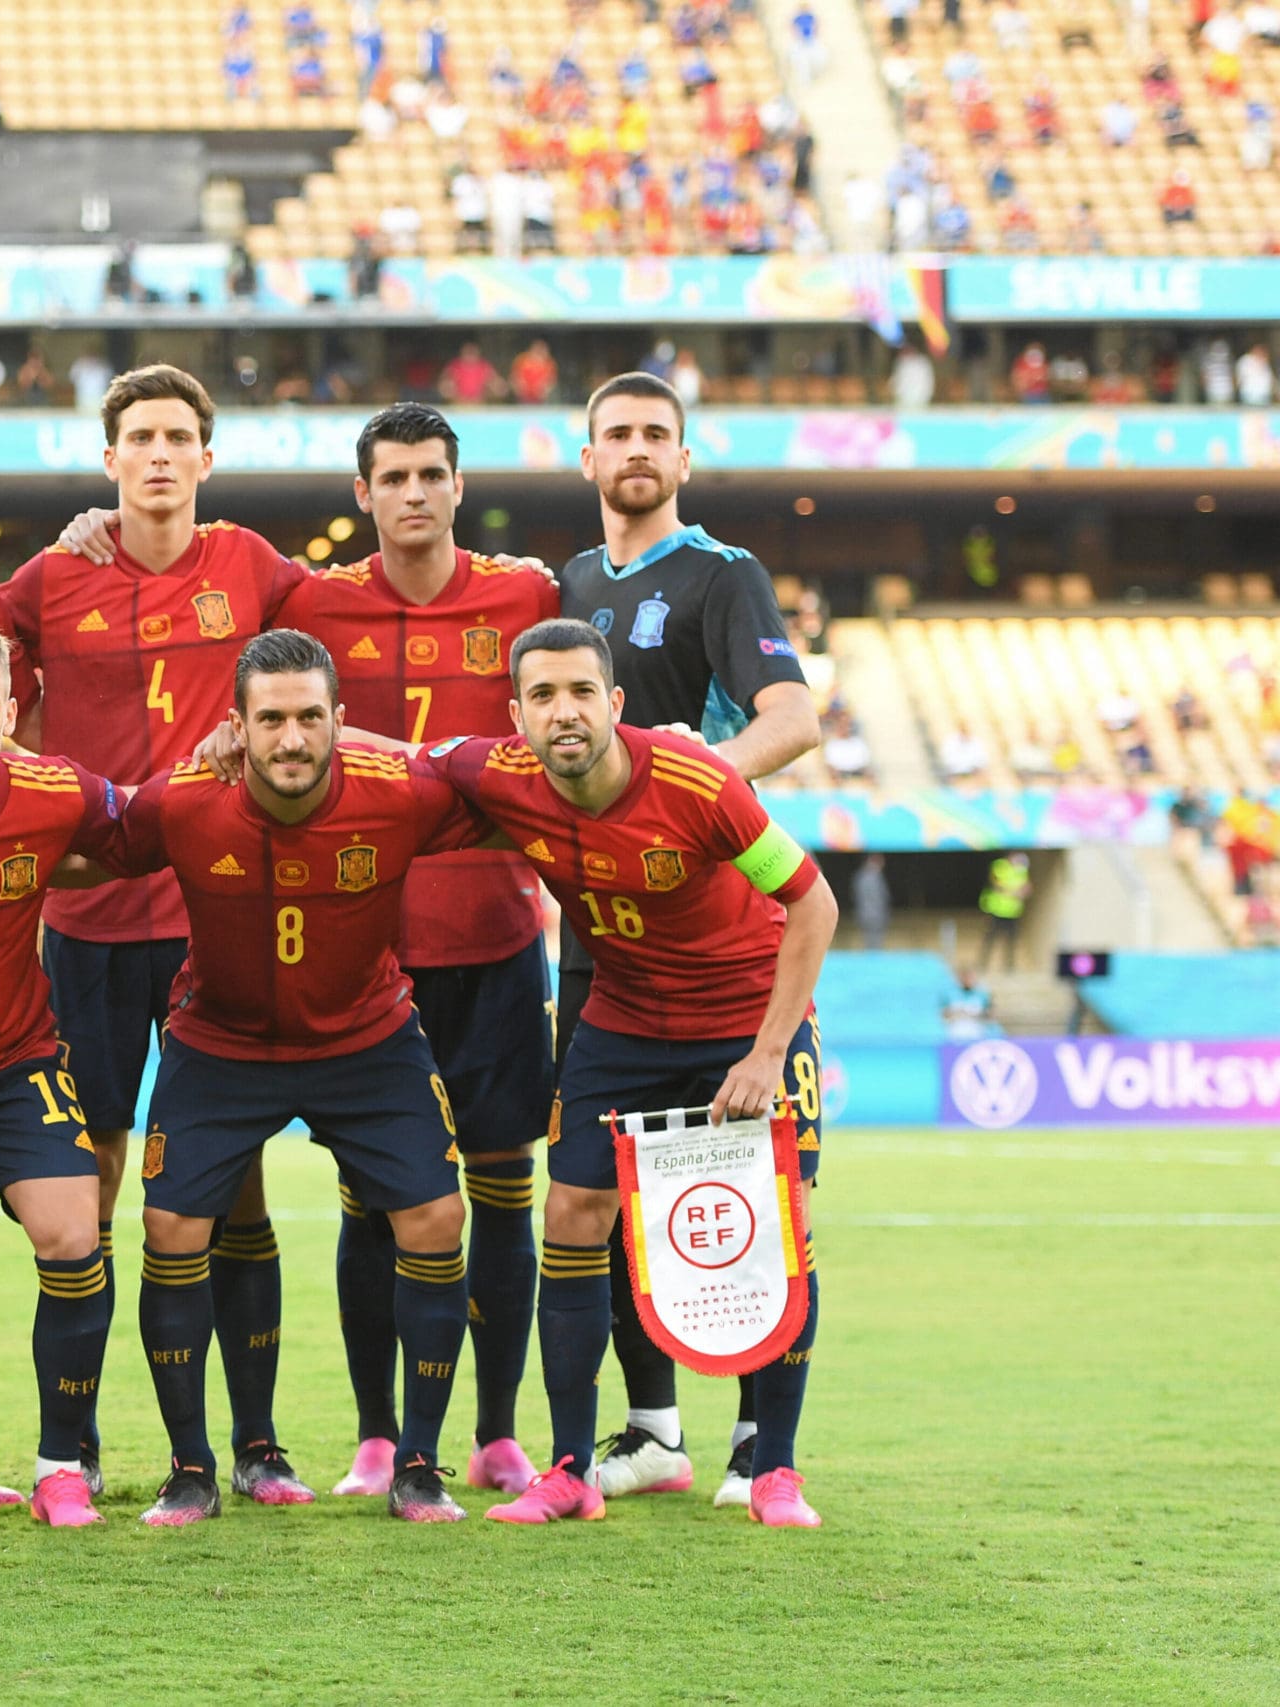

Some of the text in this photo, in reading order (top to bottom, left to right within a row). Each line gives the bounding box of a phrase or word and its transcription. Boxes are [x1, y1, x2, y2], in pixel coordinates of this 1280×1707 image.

[147, 659, 174, 723] 4
[405, 687, 432, 744] 7
[210, 866, 246, 876] adidas
[277, 905, 304, 965] 8
[579, 892, 645, 939] 18
[430, 1073, 456, 1136] 8
[152, 1348, 192, 1364] RFEF
[418, 1360, 452, 1378] RFEF
